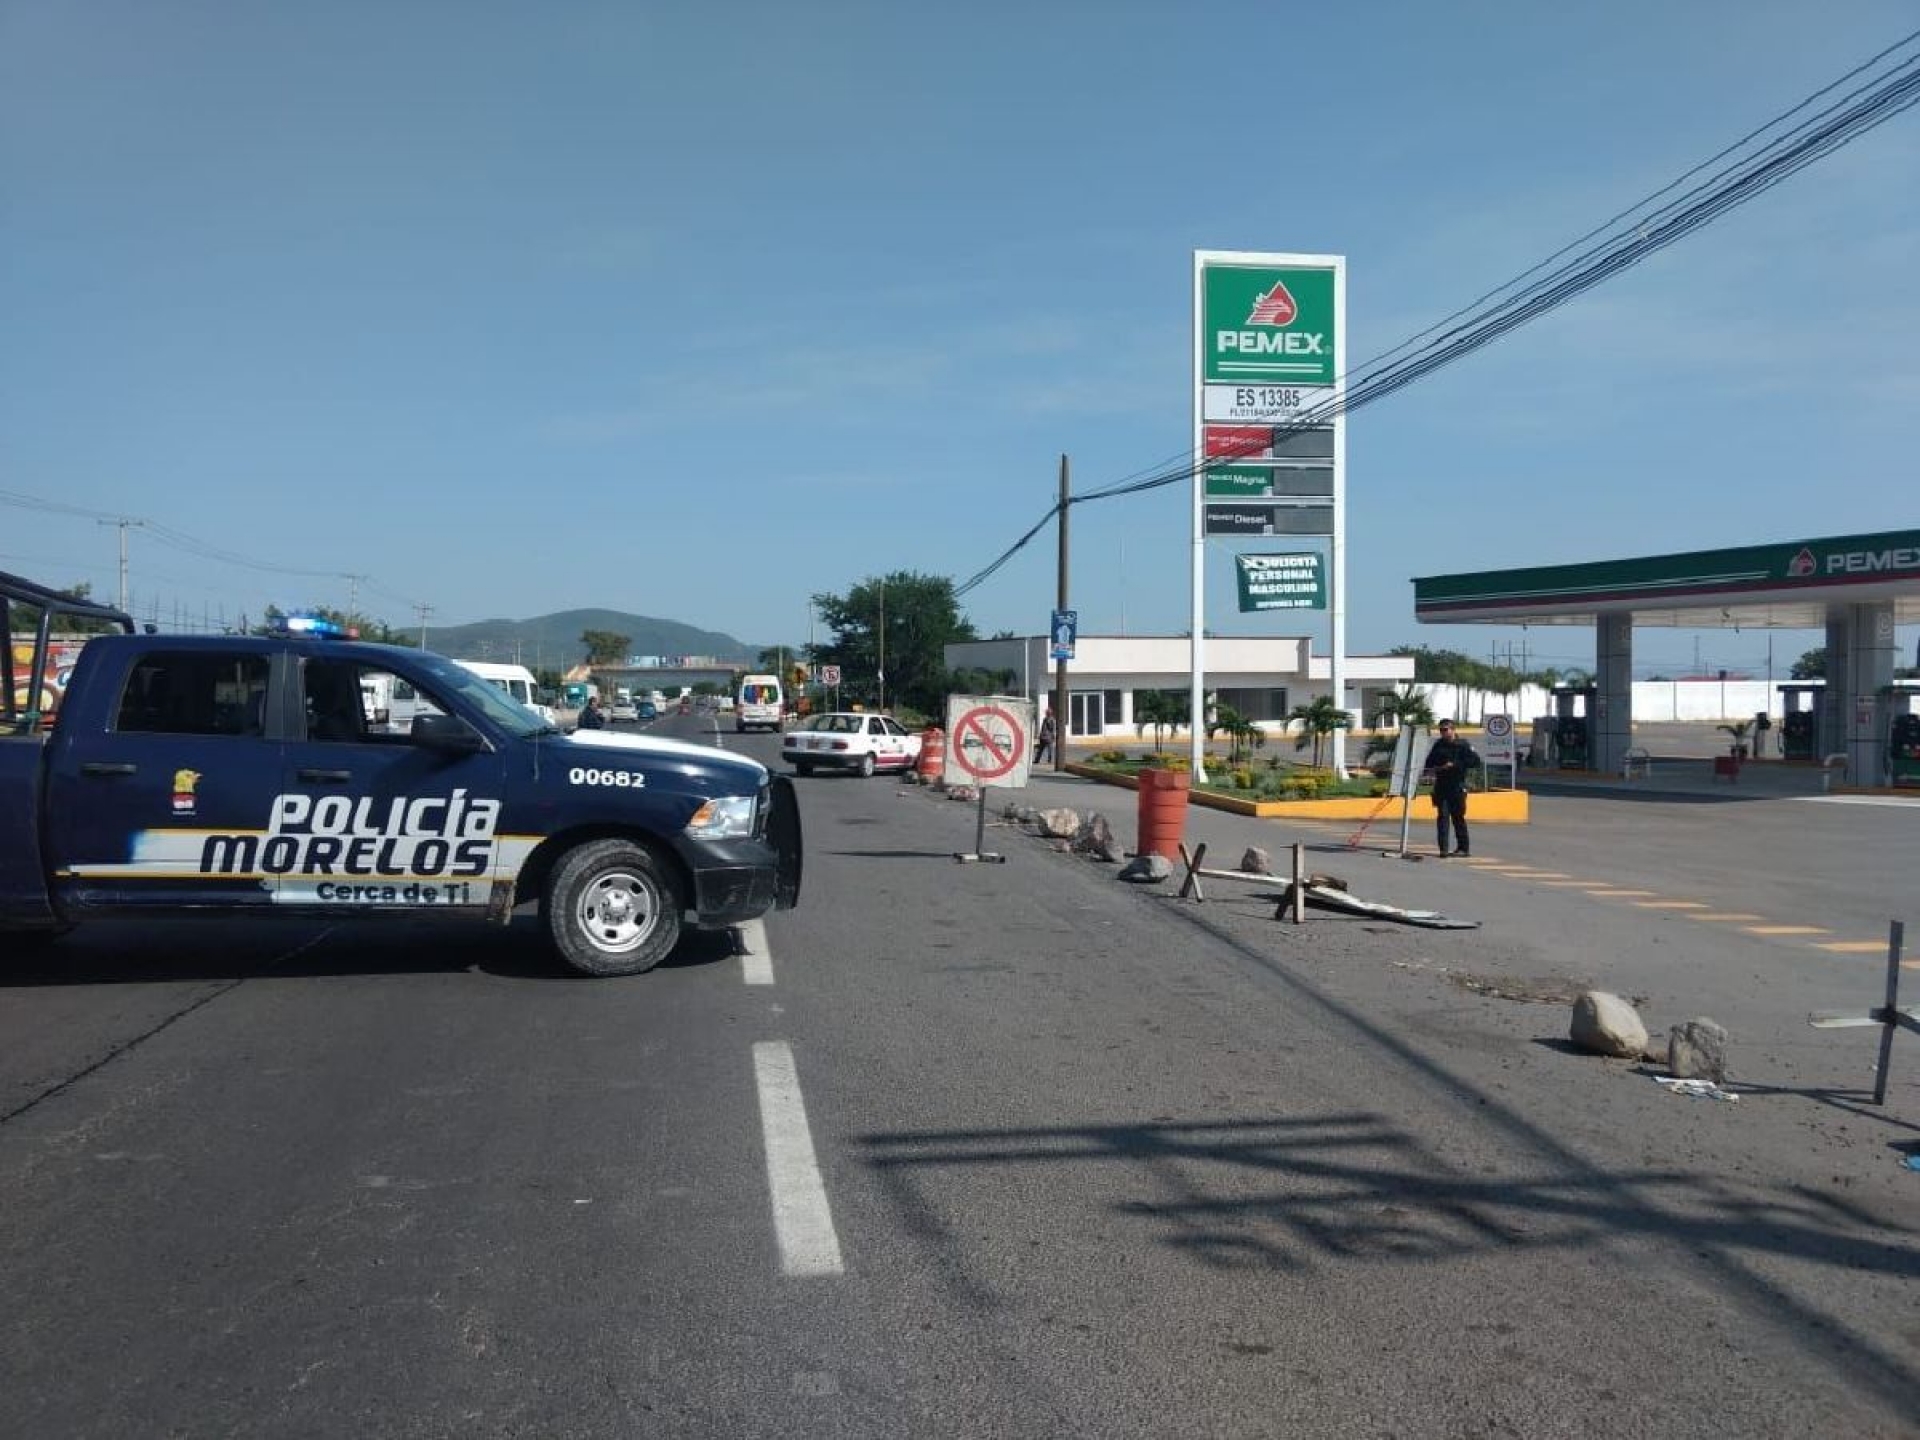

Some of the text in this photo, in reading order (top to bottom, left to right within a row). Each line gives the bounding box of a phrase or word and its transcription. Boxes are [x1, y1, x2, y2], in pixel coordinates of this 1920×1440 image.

[1216, 330, 1324, 355] PEMEX
[1236, 388, 1300, 407] ES 13385
[1234, 514, 1267, 524] Diesel
[569, 767, 646, 788] 00682
[268, 788, 500, 837] POLICÍA
[200, 834, 492, 876] MORELOS
[316, 882, 470, 903] Cerca de Ti
